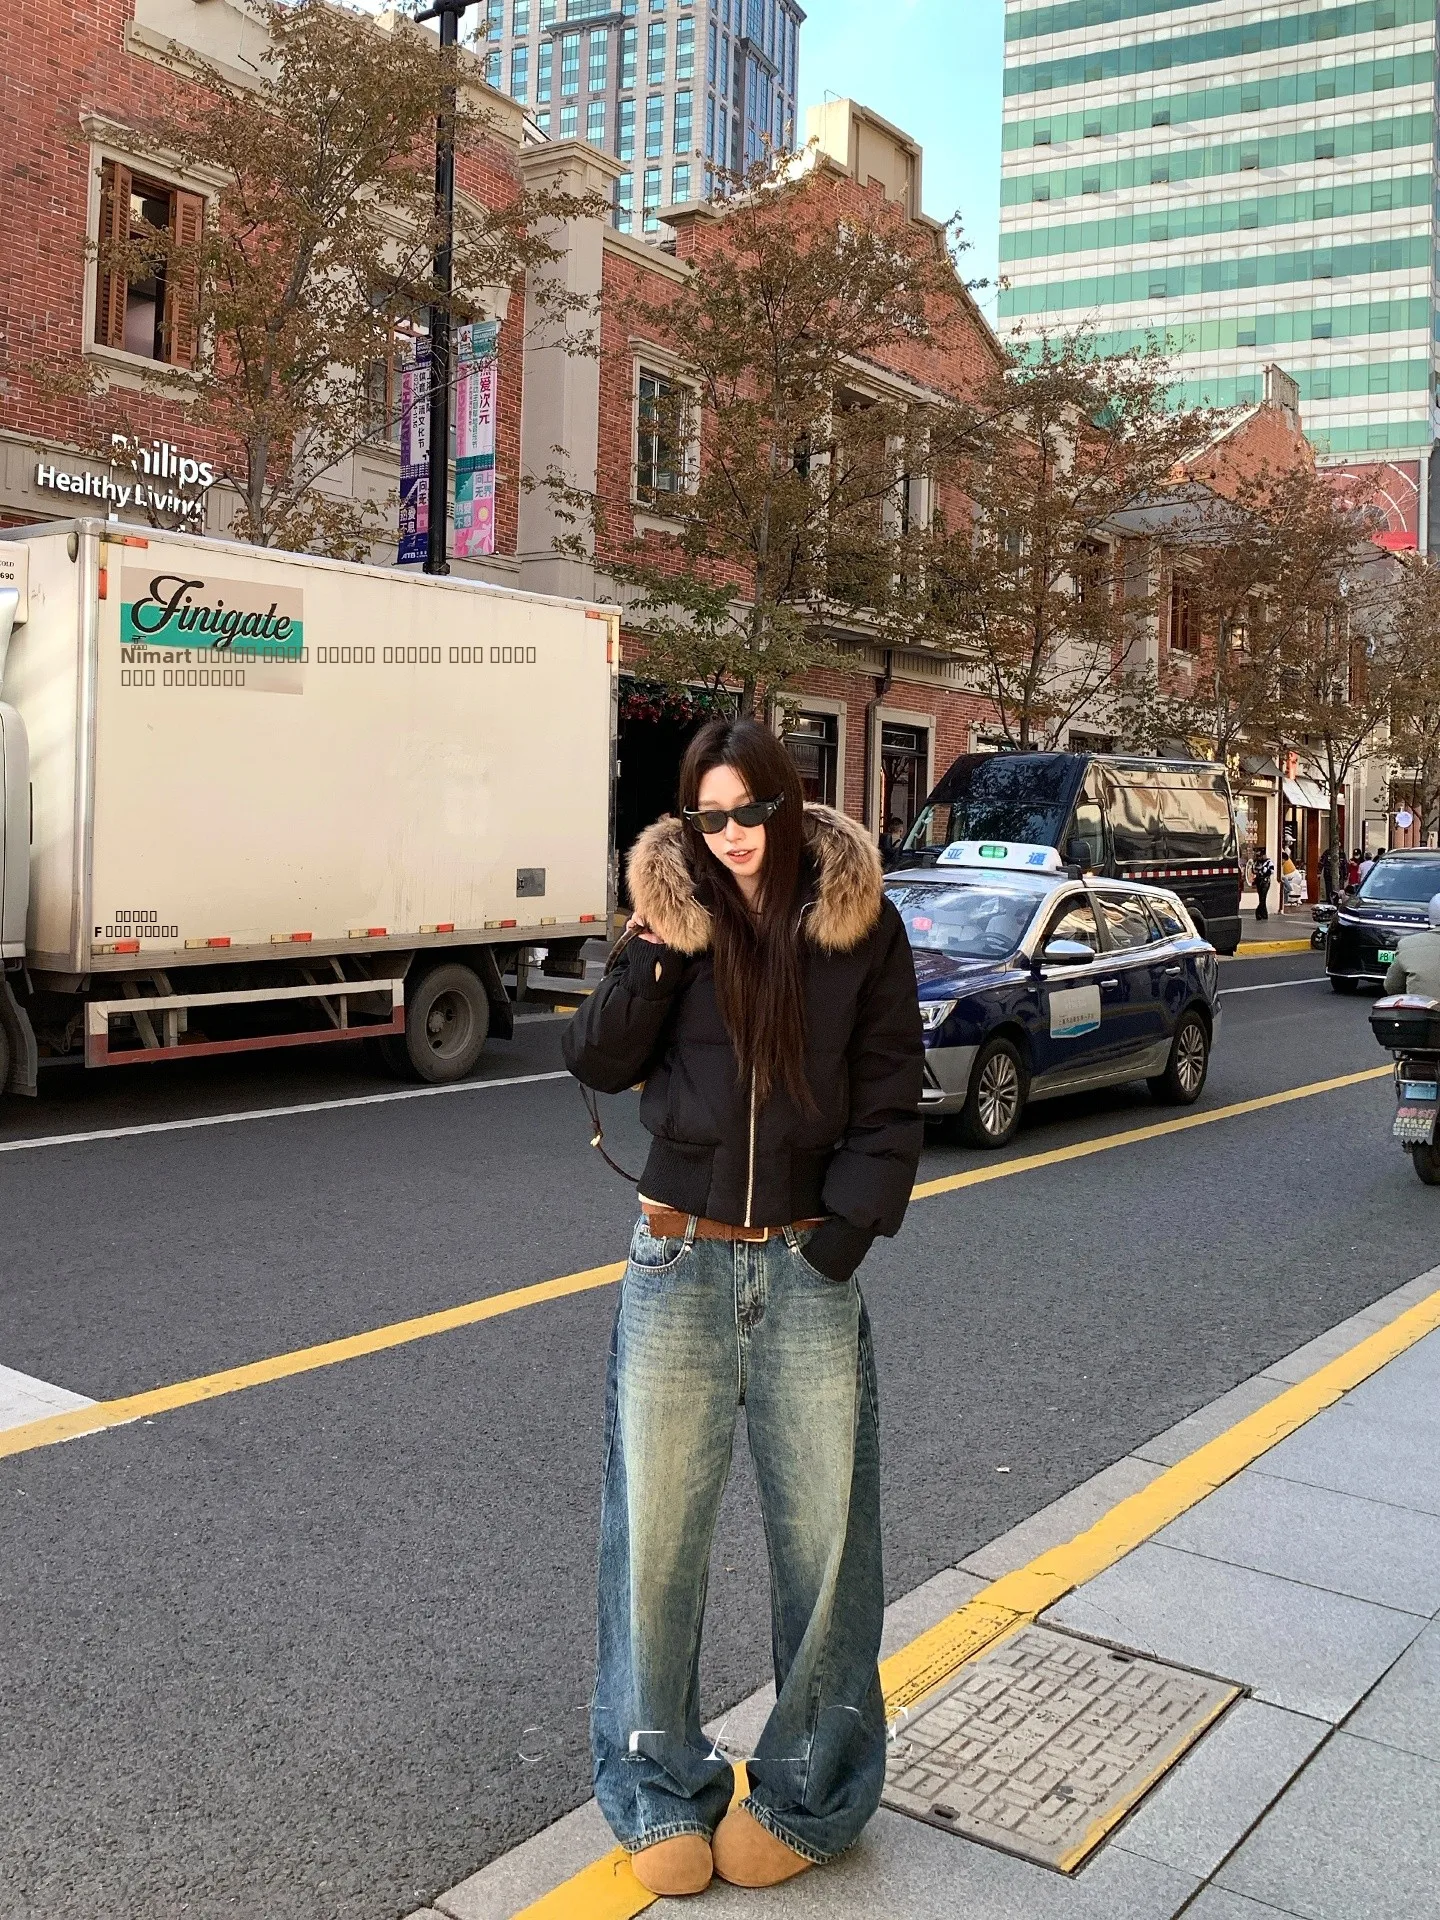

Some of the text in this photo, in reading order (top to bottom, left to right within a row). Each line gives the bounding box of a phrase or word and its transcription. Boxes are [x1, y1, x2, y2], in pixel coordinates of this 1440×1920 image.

[36, 463, 202, 523] Healthy Living
[0, 572, 15, 580] 690
[131, 575, 293, 651] Finigate
[121, 646, 192, 664] Nimart
[944, 848, 1047, 865] 亚 通
